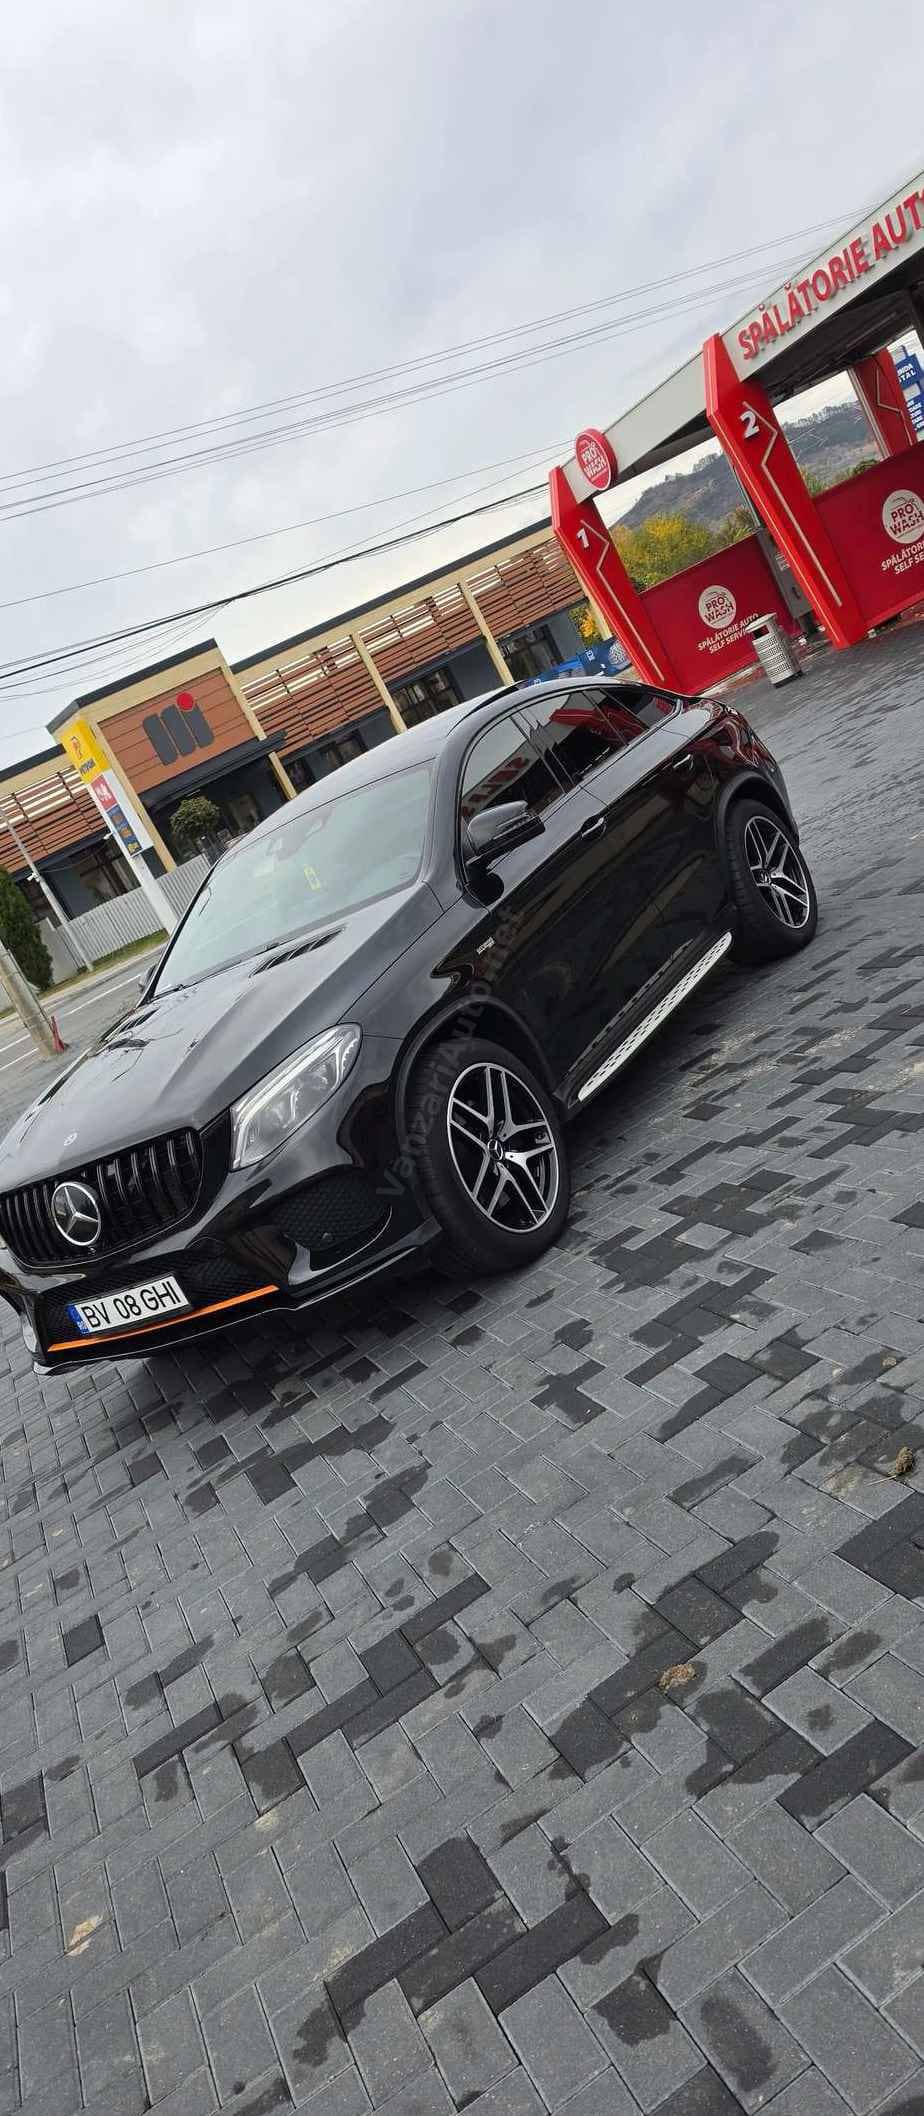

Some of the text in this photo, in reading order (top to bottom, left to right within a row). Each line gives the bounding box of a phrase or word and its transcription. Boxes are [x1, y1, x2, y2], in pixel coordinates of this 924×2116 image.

[737, 237, 870, 359] SPĂLĂTORIE
[740, 410, 760, 439] 2
[582, 447, 598, 465] PRO
[583, 455, 607, 478] WASH
[891, 503, 914, 522] PRO
[890, 511, 924, 535] WASH
[576, 527, 590, 549] 1
[894, 556, 913, 574] SELF
[704, 603, 734, 621] WASH
[705, 597, 725, 612] PRO
[709, 640, 726, 653] SELF
[81, 1302, 111, 1328] BV
[113, 1294, 142, 1319] 08
[140, 1281, 181, 1310] GHI
